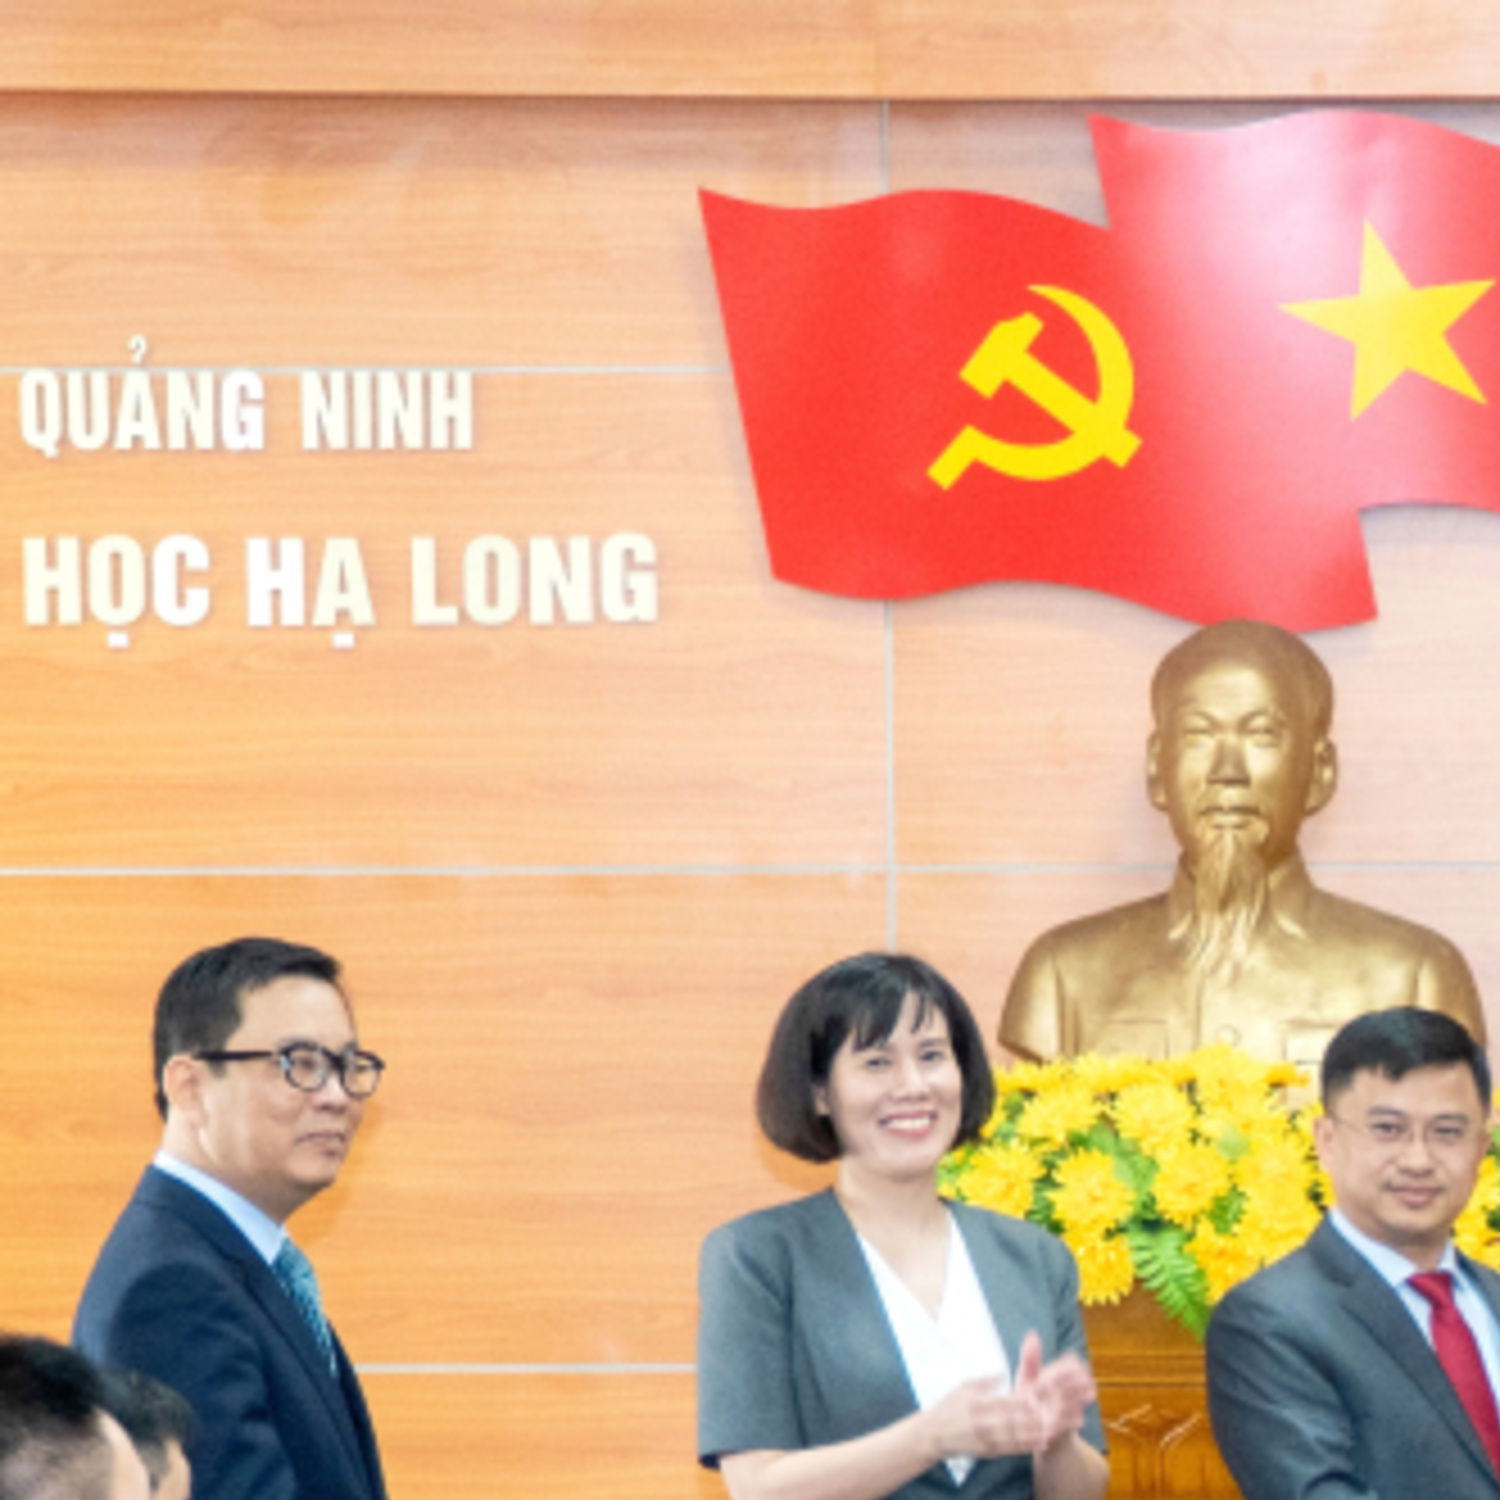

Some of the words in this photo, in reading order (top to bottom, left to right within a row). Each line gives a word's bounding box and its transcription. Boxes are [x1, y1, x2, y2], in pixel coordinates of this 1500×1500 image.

[19, 335, 266, 458] QUẢNG
[299, 368, 474, 451] NINH
[22, 533, 211, 649] HỌC
[245, 536, 376, 649] HẠ
[410, 531, 660, 626] LONG
